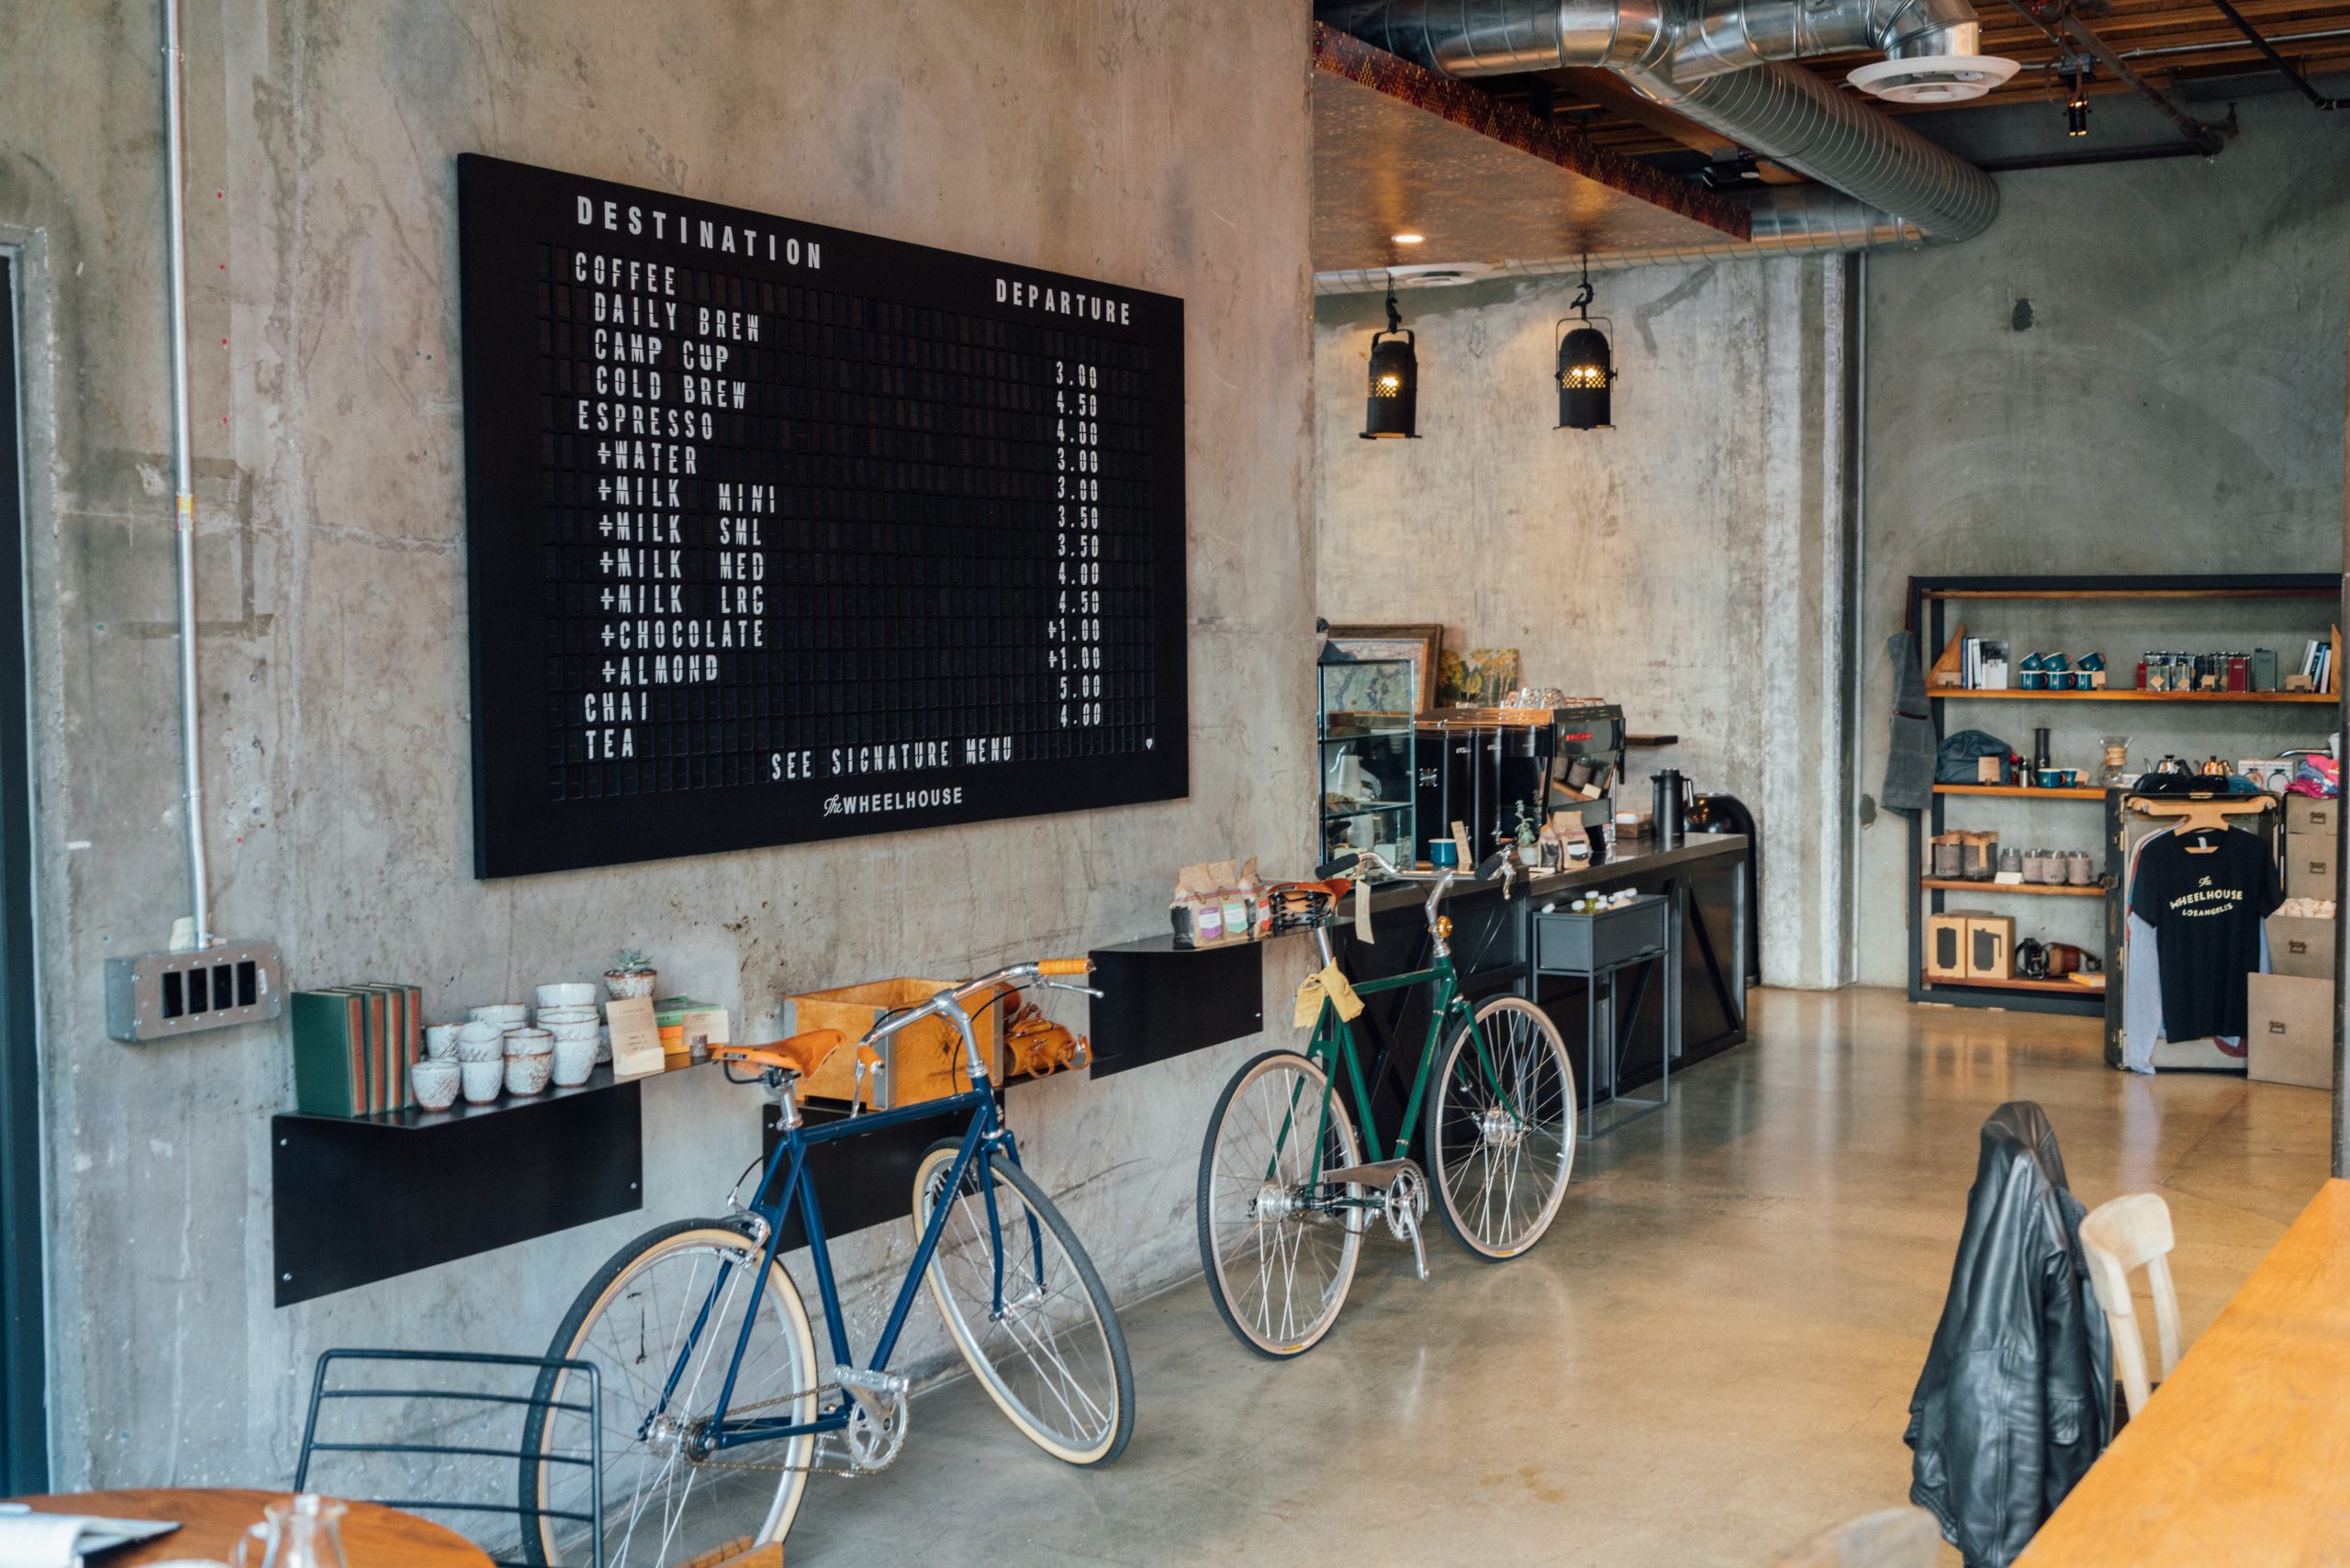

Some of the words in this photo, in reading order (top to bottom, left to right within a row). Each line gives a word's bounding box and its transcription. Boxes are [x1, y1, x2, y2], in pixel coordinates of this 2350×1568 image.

[576, 196, 821, 269] DESTINATION
[576, 252, 675, 296] COFFEE
[594, 292, 677, 331] DAILY
[699, 307, 759, 342] BREW
[996, 278, 1130, 326] DEPARTURE
[595, 328, 662, 364] CAMP
[682, 340, 729, 373] CUP
[596, 365, 661, 400] COLD
[683, 375, 745, 409] BREW
[1056, 361, 1097, 389] 3.00
[1057, 390, 1097, 418] 4.50
[578, 399, 712, 441] ESPRESSO
[1057, 419, 1098, 446] 4.00
[597, 440, 697, 475] +WATER
[1057, 447, 1099, 474] 3.00
[598, 476, 680, 508] +MILK
[718, 483, 775, 513] MINI
[1057, 476, 1099, 502] 3.00
[599, 511, 682, 543] +MILK
[720, 517, 762, 546] SML
[1058, 504, 1099, 530] 3.50
[1058, 532, 1099, 558] 3.50
[599, 547, 682, 578] +MILK
[720, 552, 764, 581] MED
[1058, 561, 1100, 586] 4.00
[600, 584, 683, 614] +MILK
[721, 585, 764, 615] LRG
[1058, 590, 1100, 614] 4.50
[600, 620, 763, 650] +CHOCOLATE
[1047, 617, 1100, 643] +1.00
[601, 654, 718, 686] +ALMOND
[1048, 646, 1101, 671] +1.00
[1059, 675, 1101, 700] 5.00
[584, 691, 647, 722] CHAI
[1060, 702, 1101, 728] 4.00
[585, 728, 633, 760] TEA
[771, 750, 811, 780] SEE
[832, 740, 949, 775] SIGNATURE
[966, 735, 1012, 765] MENU
[822, 793, 843, 817] The
[843, 787, 963, 815] WHEELHOUSE
[2169, 890, 2243, 910] WHEELHOUSE
